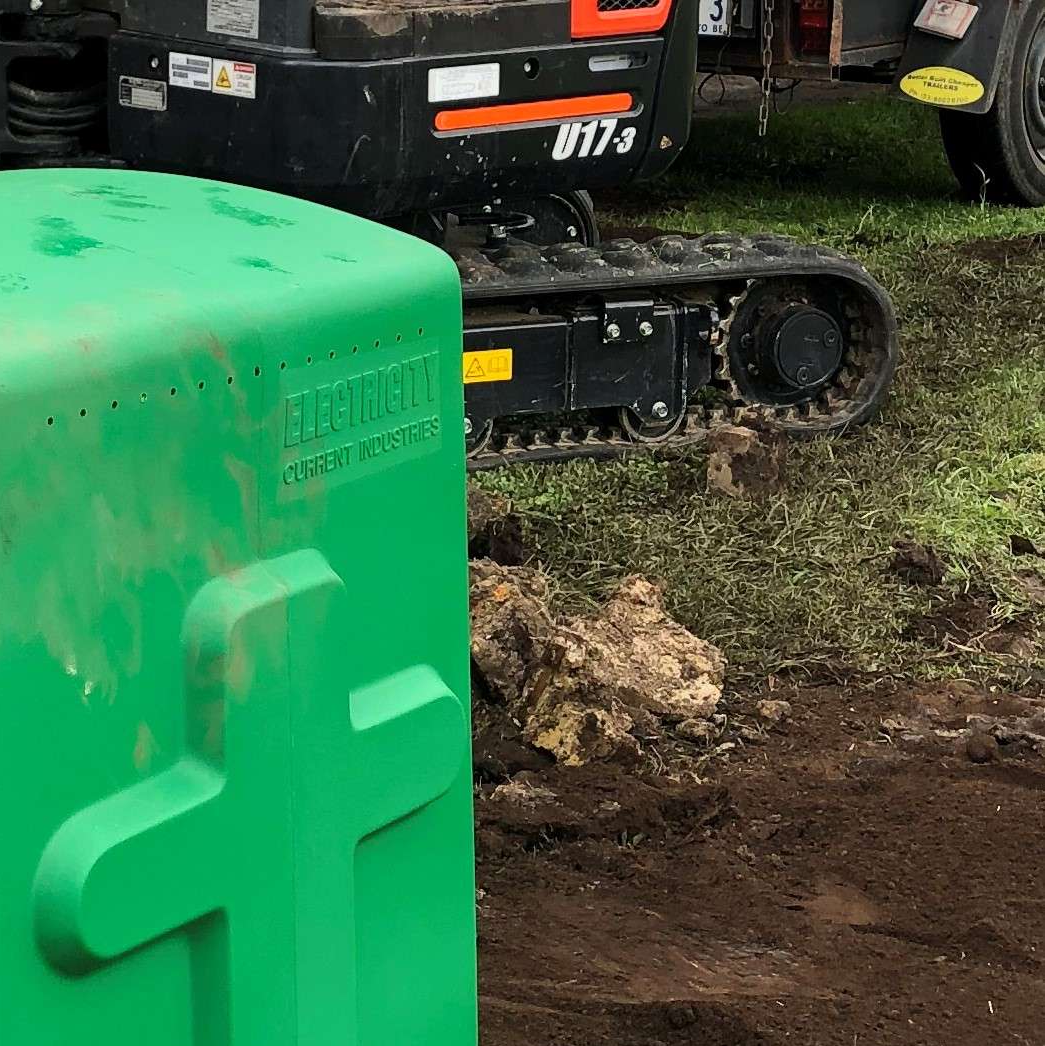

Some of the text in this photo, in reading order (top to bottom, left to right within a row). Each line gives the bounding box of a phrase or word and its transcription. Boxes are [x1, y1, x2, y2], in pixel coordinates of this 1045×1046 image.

[699, 24, 723, 33] O BE
[923, 80, 959, 91] TRAILERS
[551, 118, 637, 161] U17-3
[283, 350, 440, 449] ELECTRICITY
[282, 414, 441, 486] CURRENT INDUSTRIES
